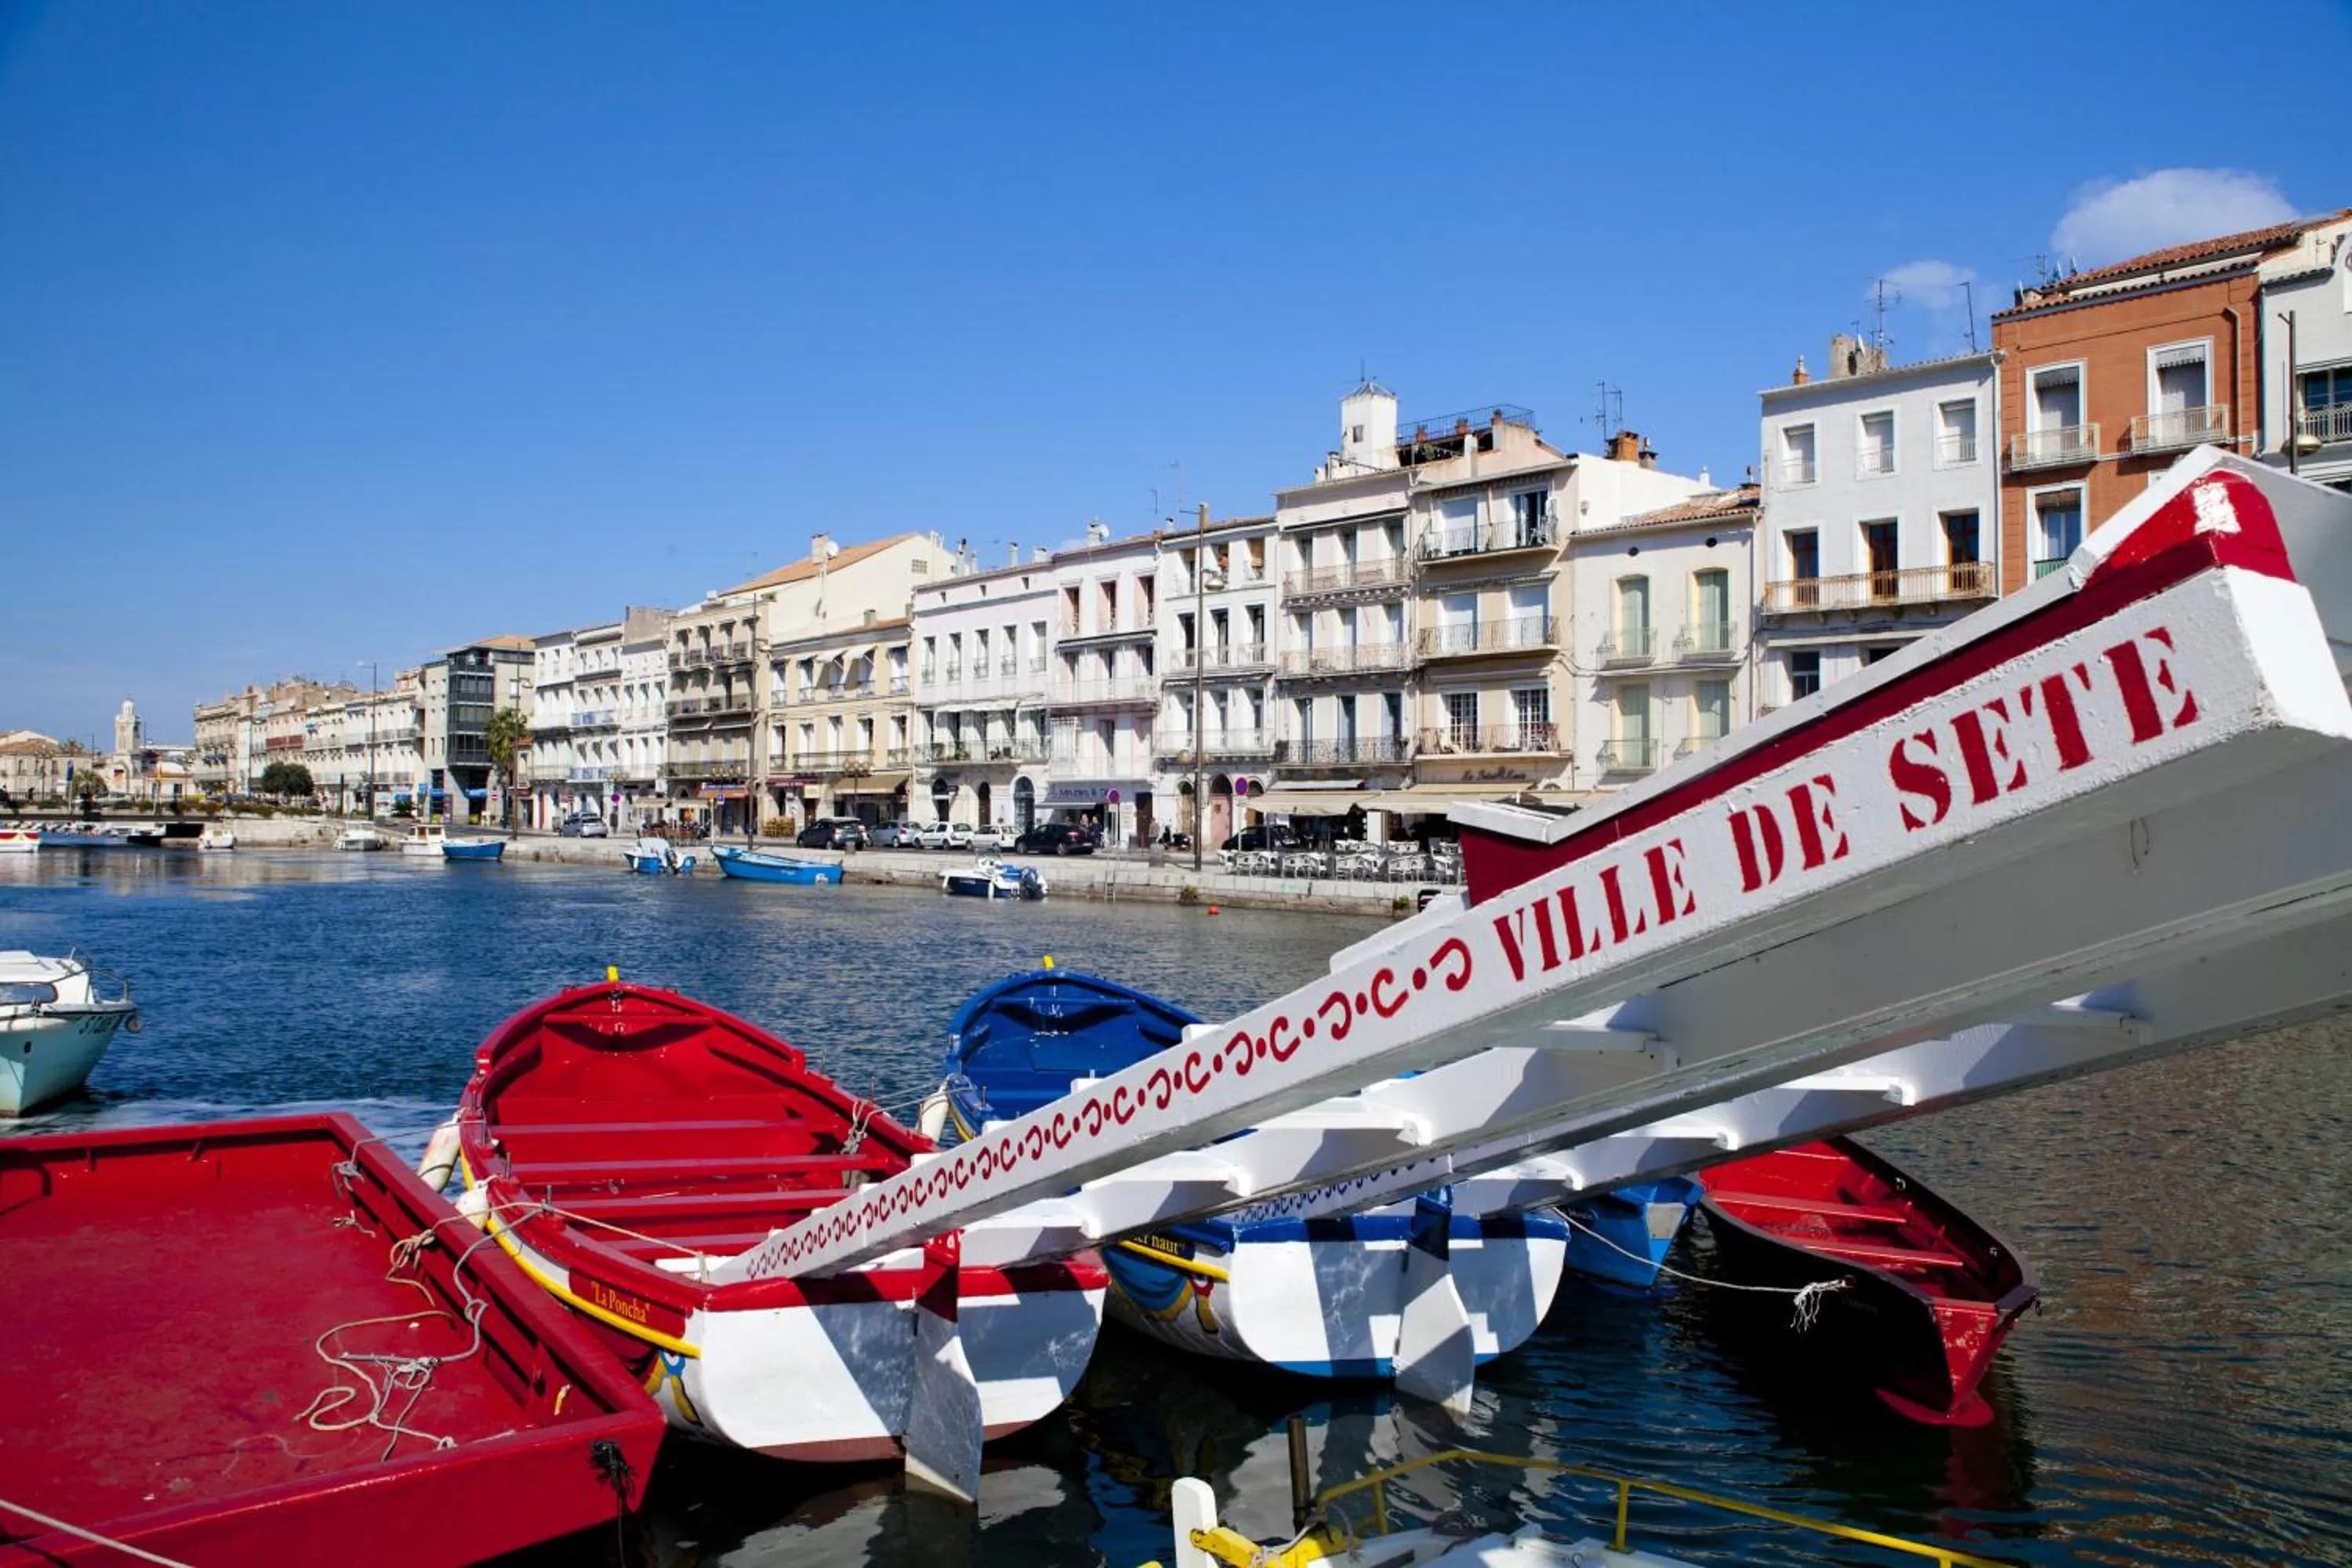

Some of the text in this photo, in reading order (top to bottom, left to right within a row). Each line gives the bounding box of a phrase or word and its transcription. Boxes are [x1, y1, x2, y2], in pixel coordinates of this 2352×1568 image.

[1493, 627, 2199, 982] VILLE DE SETE
